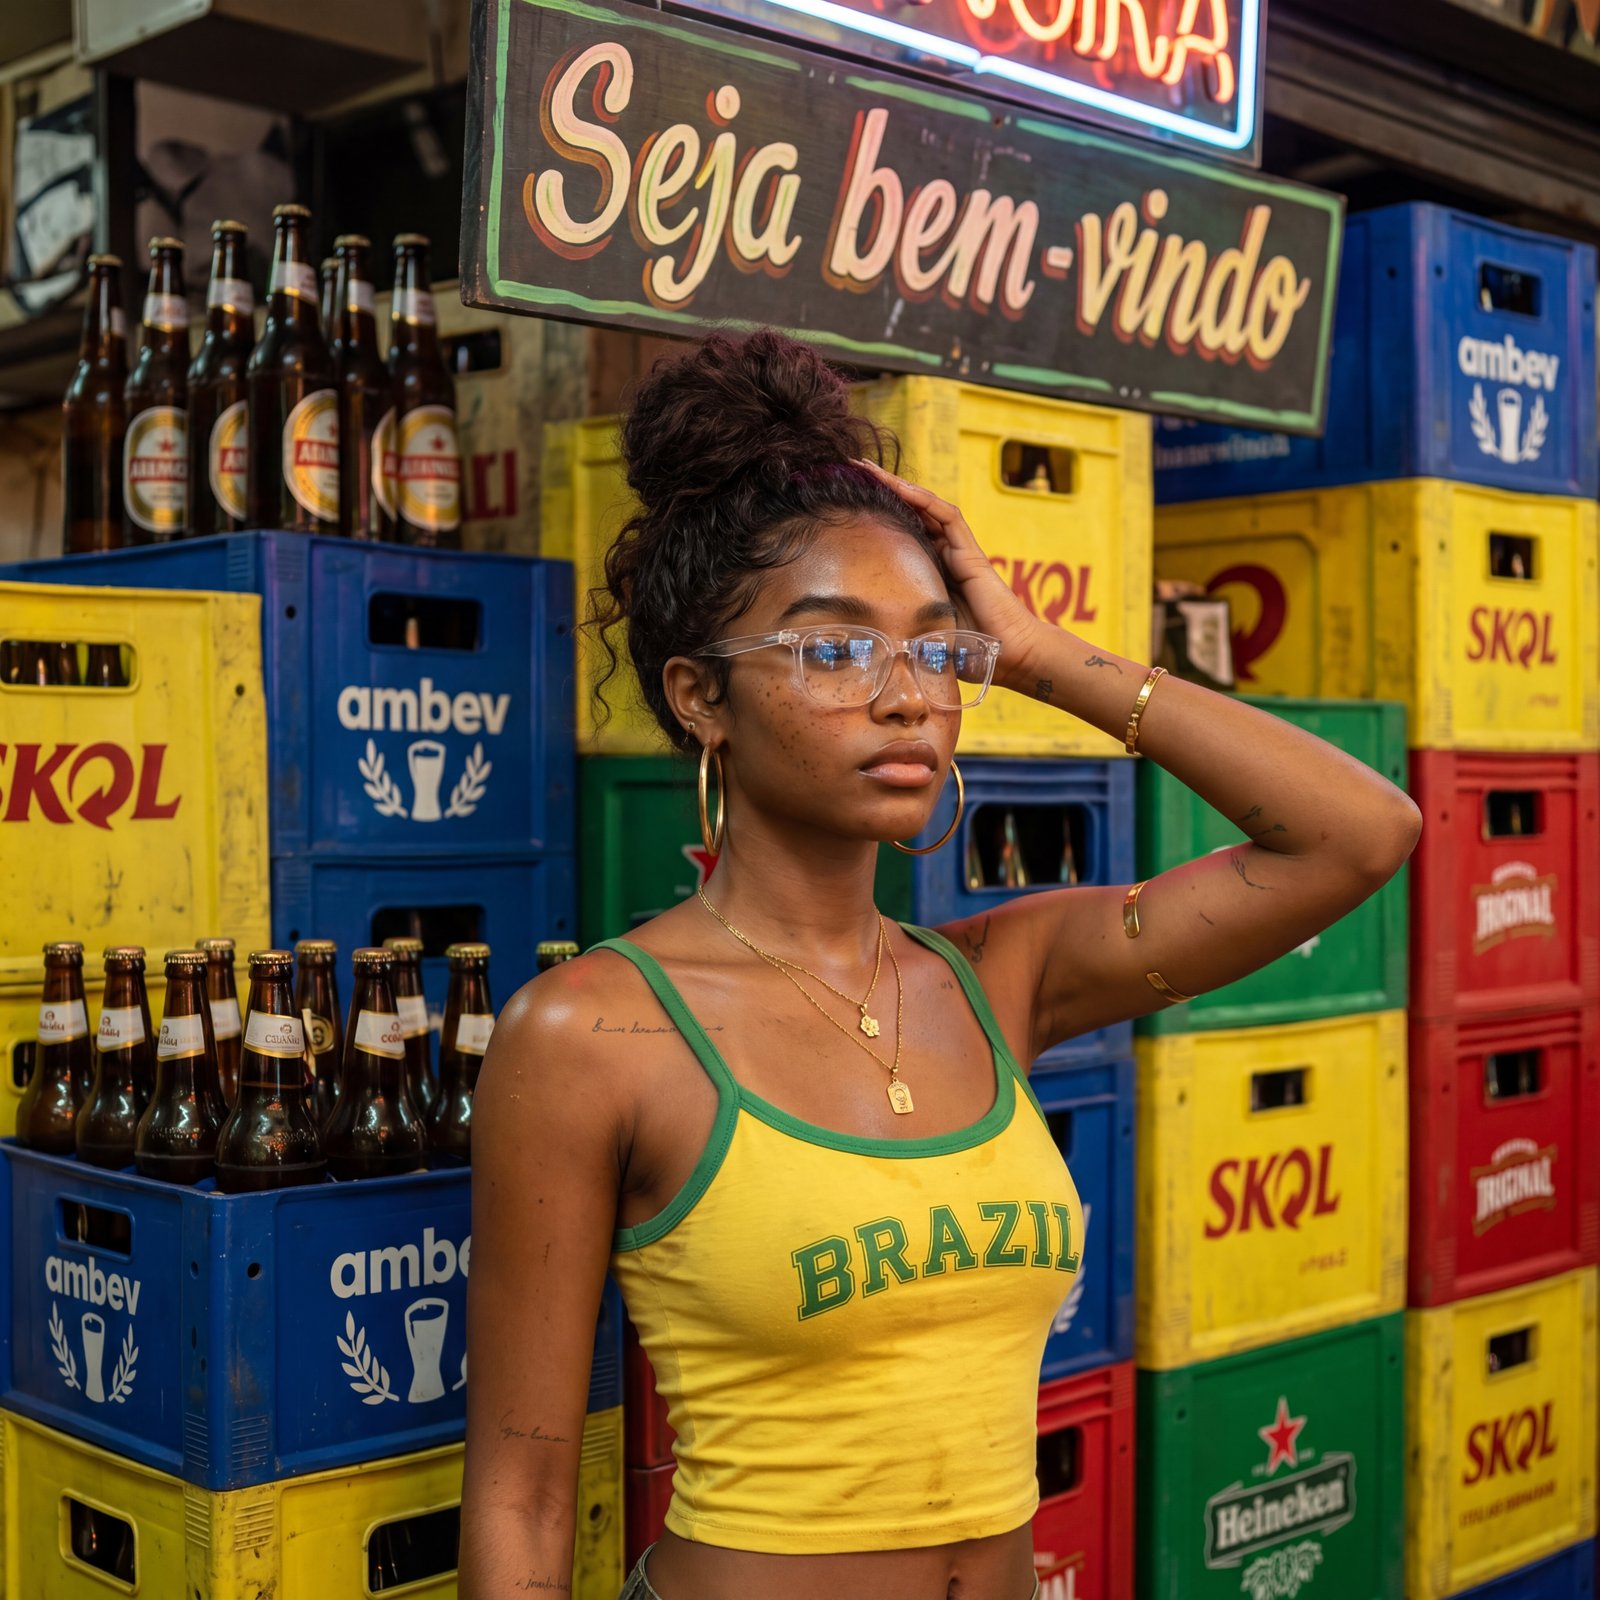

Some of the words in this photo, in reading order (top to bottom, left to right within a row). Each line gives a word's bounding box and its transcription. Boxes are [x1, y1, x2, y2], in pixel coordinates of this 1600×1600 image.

[528, 41, 803, 308] Seja
[824, 107, 1312, 368] bem-vindo
[1458, 333, 1560, 392] ambev
[988, 556, 1099, 627] KOL
[337, 677, 511, 735] ambev
[0, 740, 183, 832] KOL
[45, 1256, 141, 1316] ambev
[790, 1200, 1080, 1322] BRAZIL
[1216, 1479, 1346, 1550] Heineken
